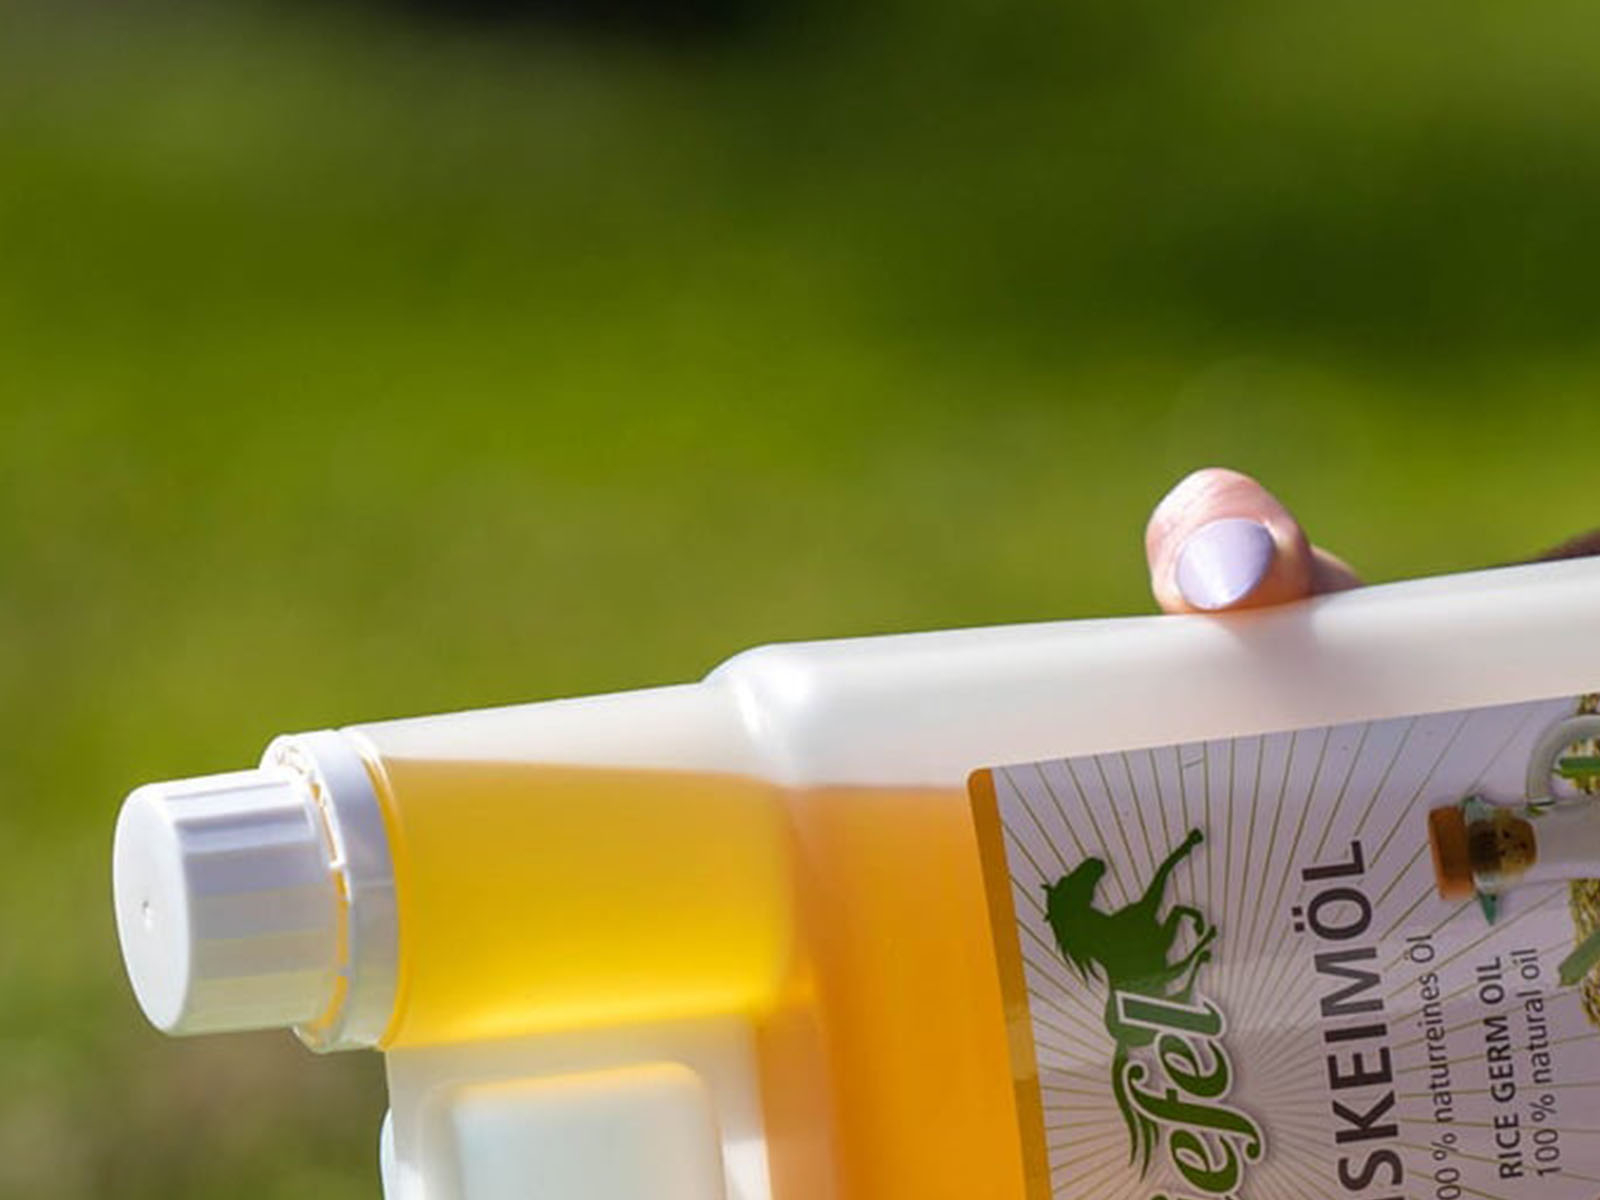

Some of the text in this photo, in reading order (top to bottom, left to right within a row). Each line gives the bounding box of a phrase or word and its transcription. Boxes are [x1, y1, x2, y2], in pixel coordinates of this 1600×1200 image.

[1403, 934, 1435, 964] Öl
[1418, 972, 1453, 1123] naturreines
[1476, 957, 1524, 1179] RICE GERM OIL
[1510, 948, 1561, 1177] 100 % natural oil
[1431, 1132, 1459, 1161] %
